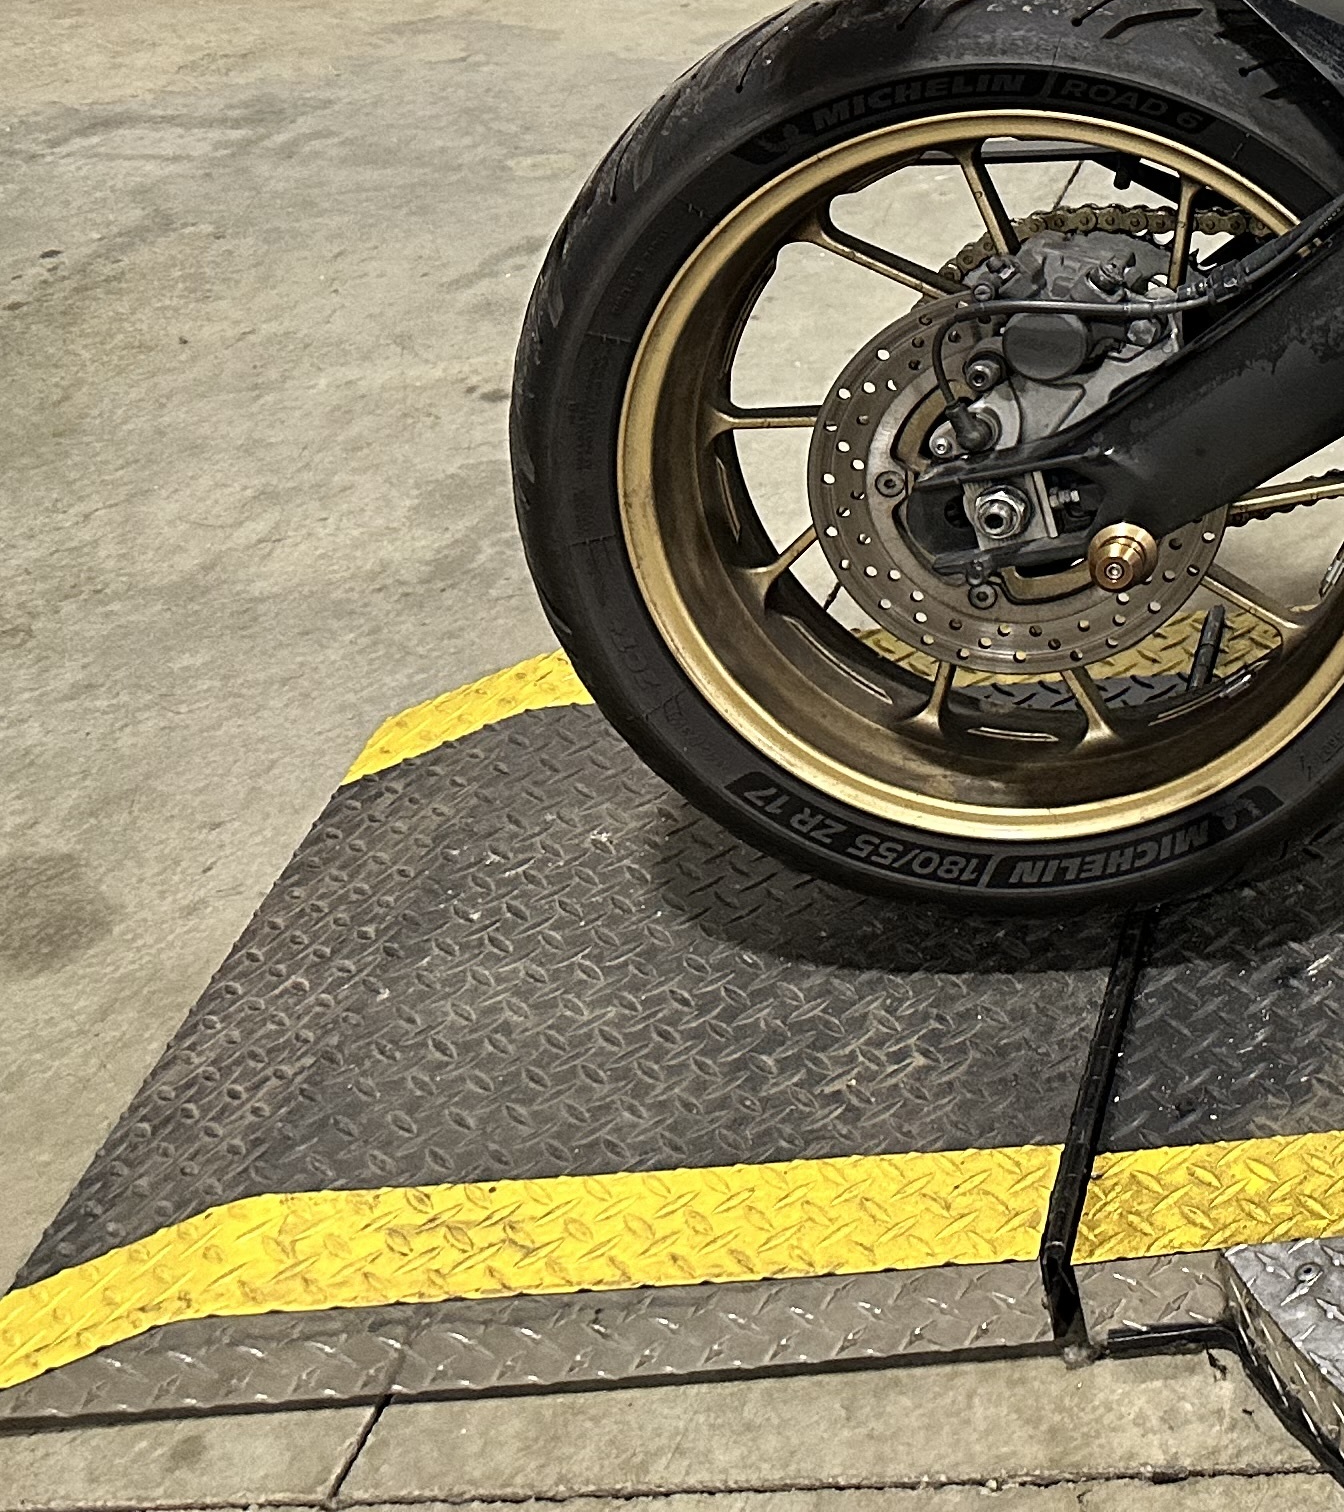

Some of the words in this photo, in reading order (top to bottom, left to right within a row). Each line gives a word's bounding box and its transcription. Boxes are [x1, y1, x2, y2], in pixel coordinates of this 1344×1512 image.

[811, 74, 1027, 130] MICHELIN
[1061, 78, 1168, 120] ROAD
[1174, 109, 1205, 133] 6
[742, 784, 790, 814] 17
[789, 808, 842, 849] ZR
[849, 834, 980, 885] 180/55
[1008, 826, 1211, 885] MICHELIN
